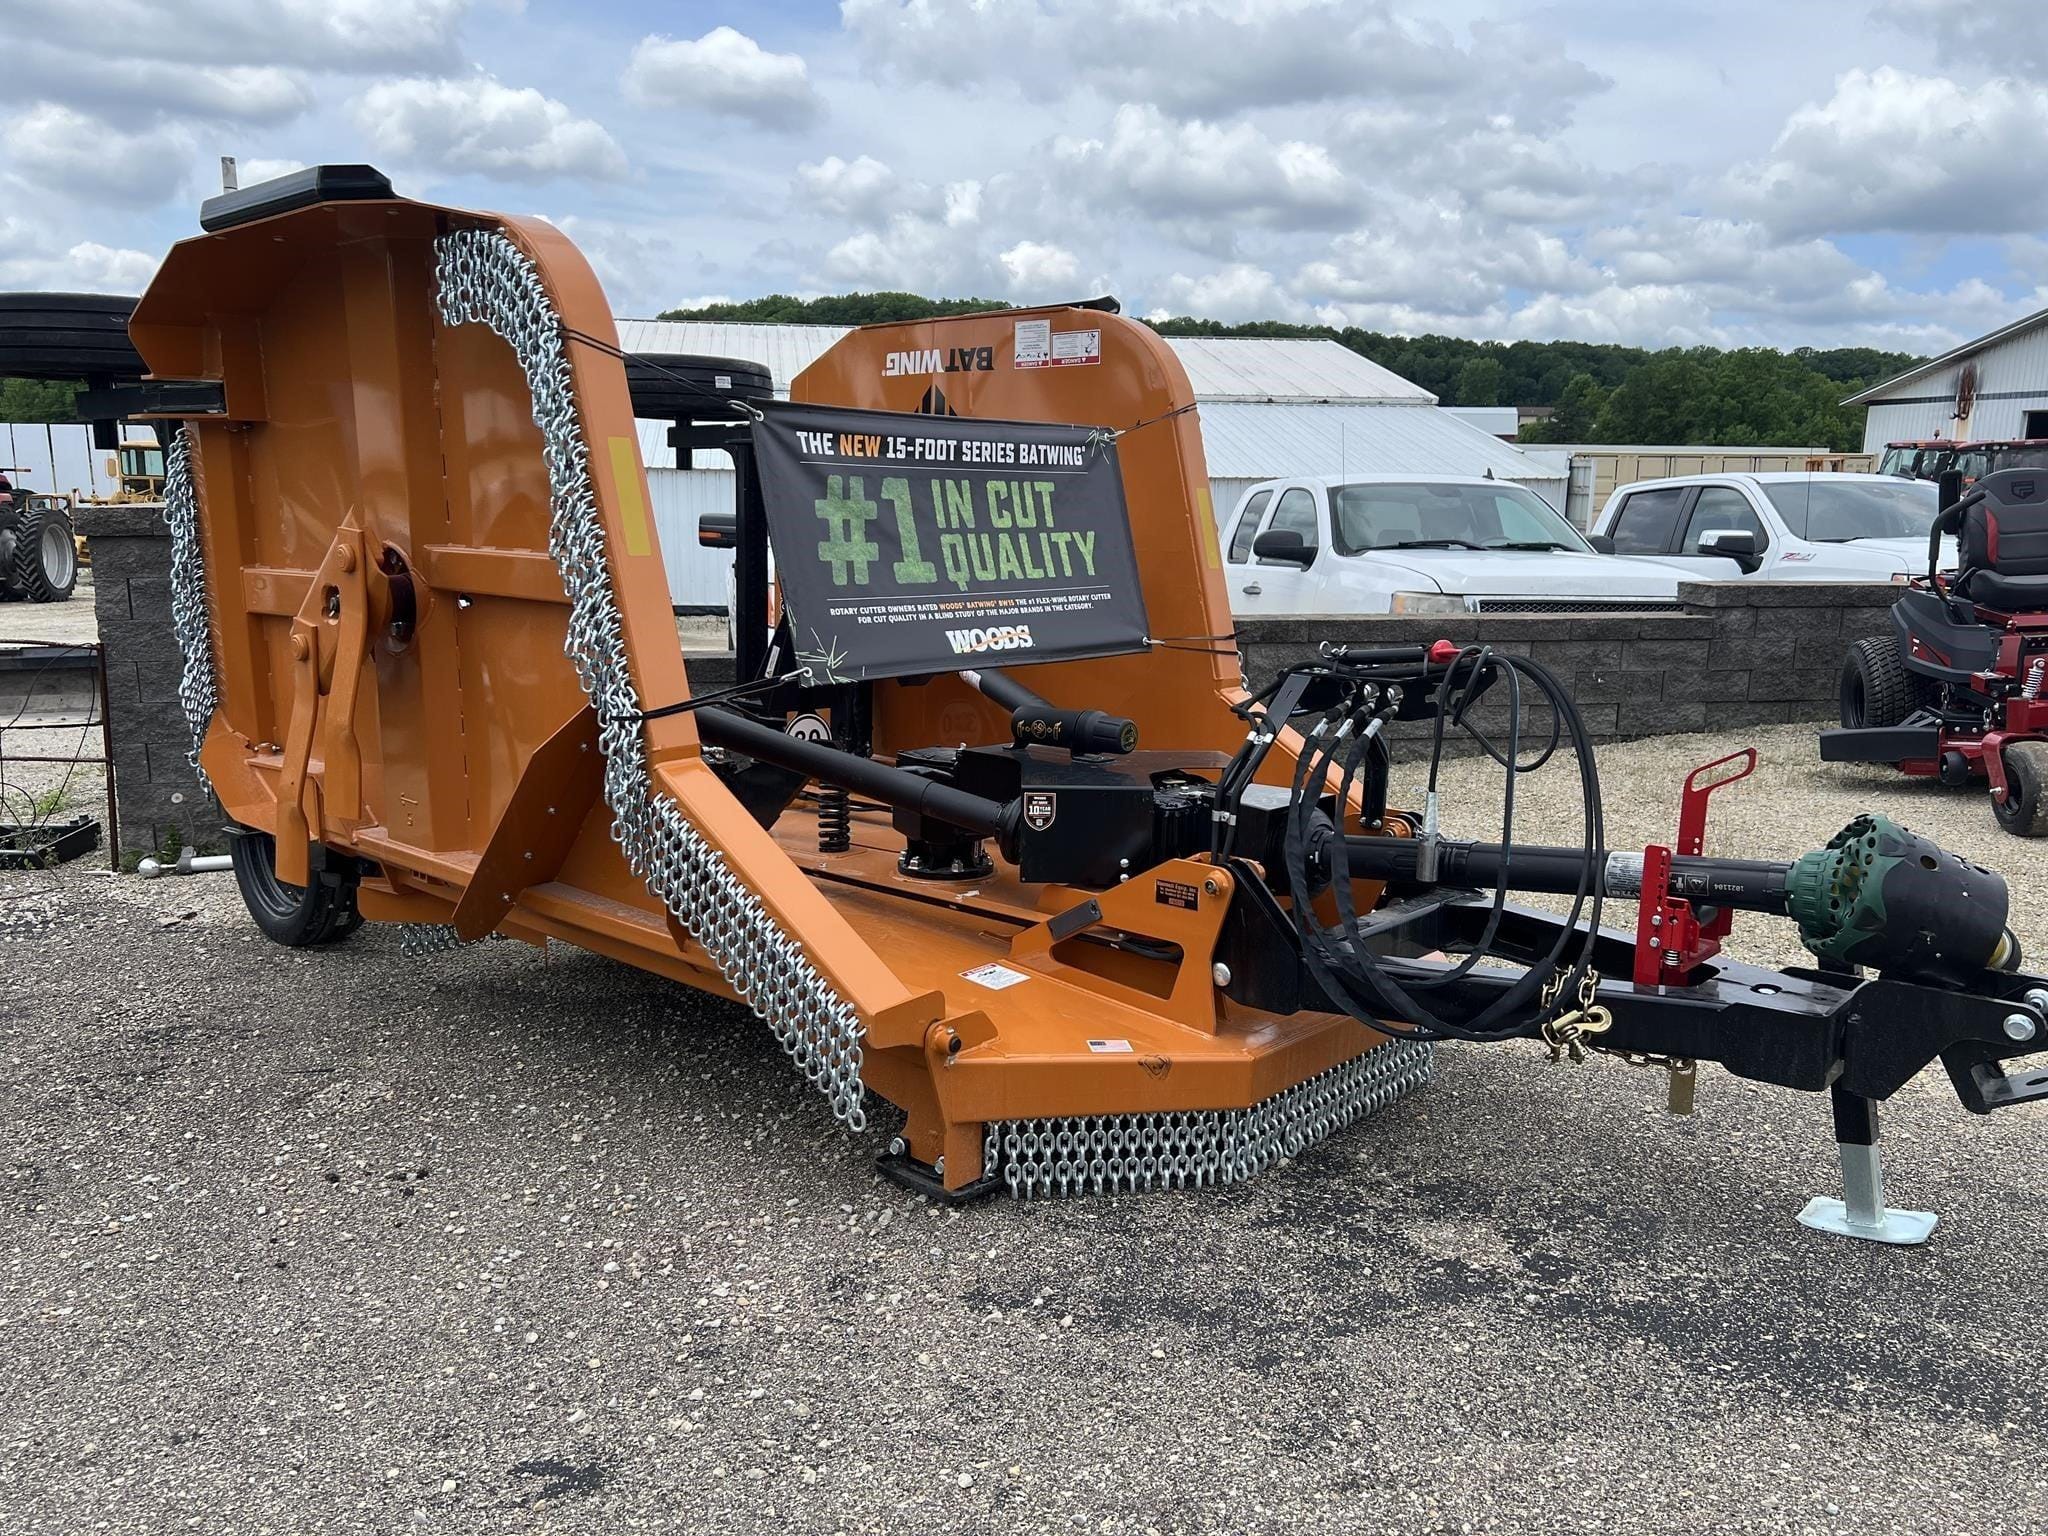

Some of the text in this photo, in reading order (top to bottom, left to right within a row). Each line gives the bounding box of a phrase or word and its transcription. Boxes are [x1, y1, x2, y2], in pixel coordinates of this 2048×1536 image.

[796, 431, 835, 456] THE
[840, 434, 881, 458] NEW
[886, 436, 957, 461] 15-FOOT
[962, 441, 1015, 464] SERIES
[931, 479, 1055, 528] IN CUT
[815, 474, 937, 585] #1
[940, 531, 1096, 591] QUALITY
[830, 608, 858, 616] ROTARY
[859, 606, 887, 615] CUTTER
[888, 605, 916, 613] OWNERS
[917, 603, 938, 611] RATED
[1015, 598, 1027, 606] THE
[1036, 595, 1067, 604] FLEX-WING
[1090, 593, 1111, 601] CUTTER
[857, 603, 1094, 624] FOR CUT QUALITY IN A BLIND STUDY OF THE MAJOR BRANDS IN THE CATEGORY.
[945, 625, 1034, 653] WOODS
[1029, 805, 1040, 814] 10
